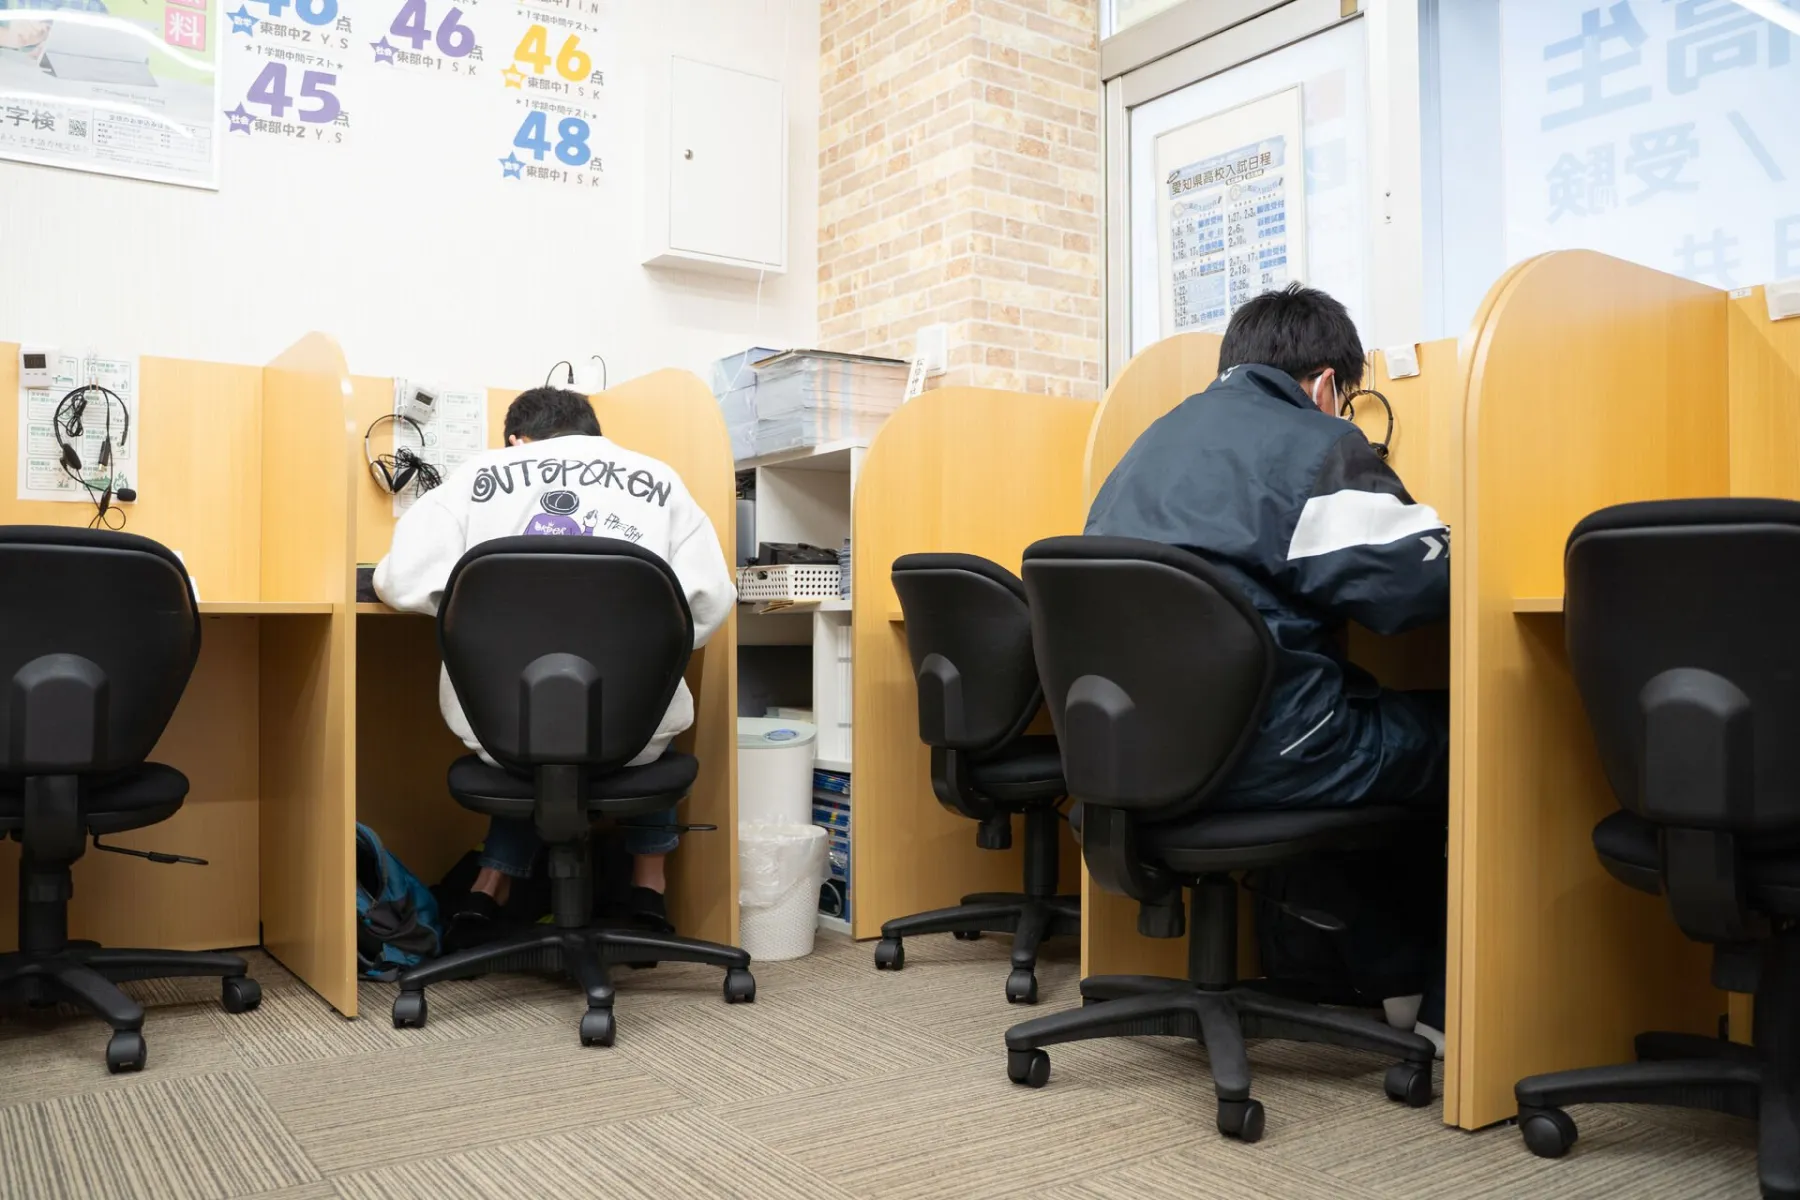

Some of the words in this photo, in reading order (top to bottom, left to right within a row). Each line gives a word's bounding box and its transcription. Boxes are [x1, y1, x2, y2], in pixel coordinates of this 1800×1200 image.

[167, 1, 203, 46] 料
[260, 21, 312, 42] 東部中2
[254, 119, 306, 138] 東部中2
[1171, 151, 1273, 196] 愛知県高校入試日程
